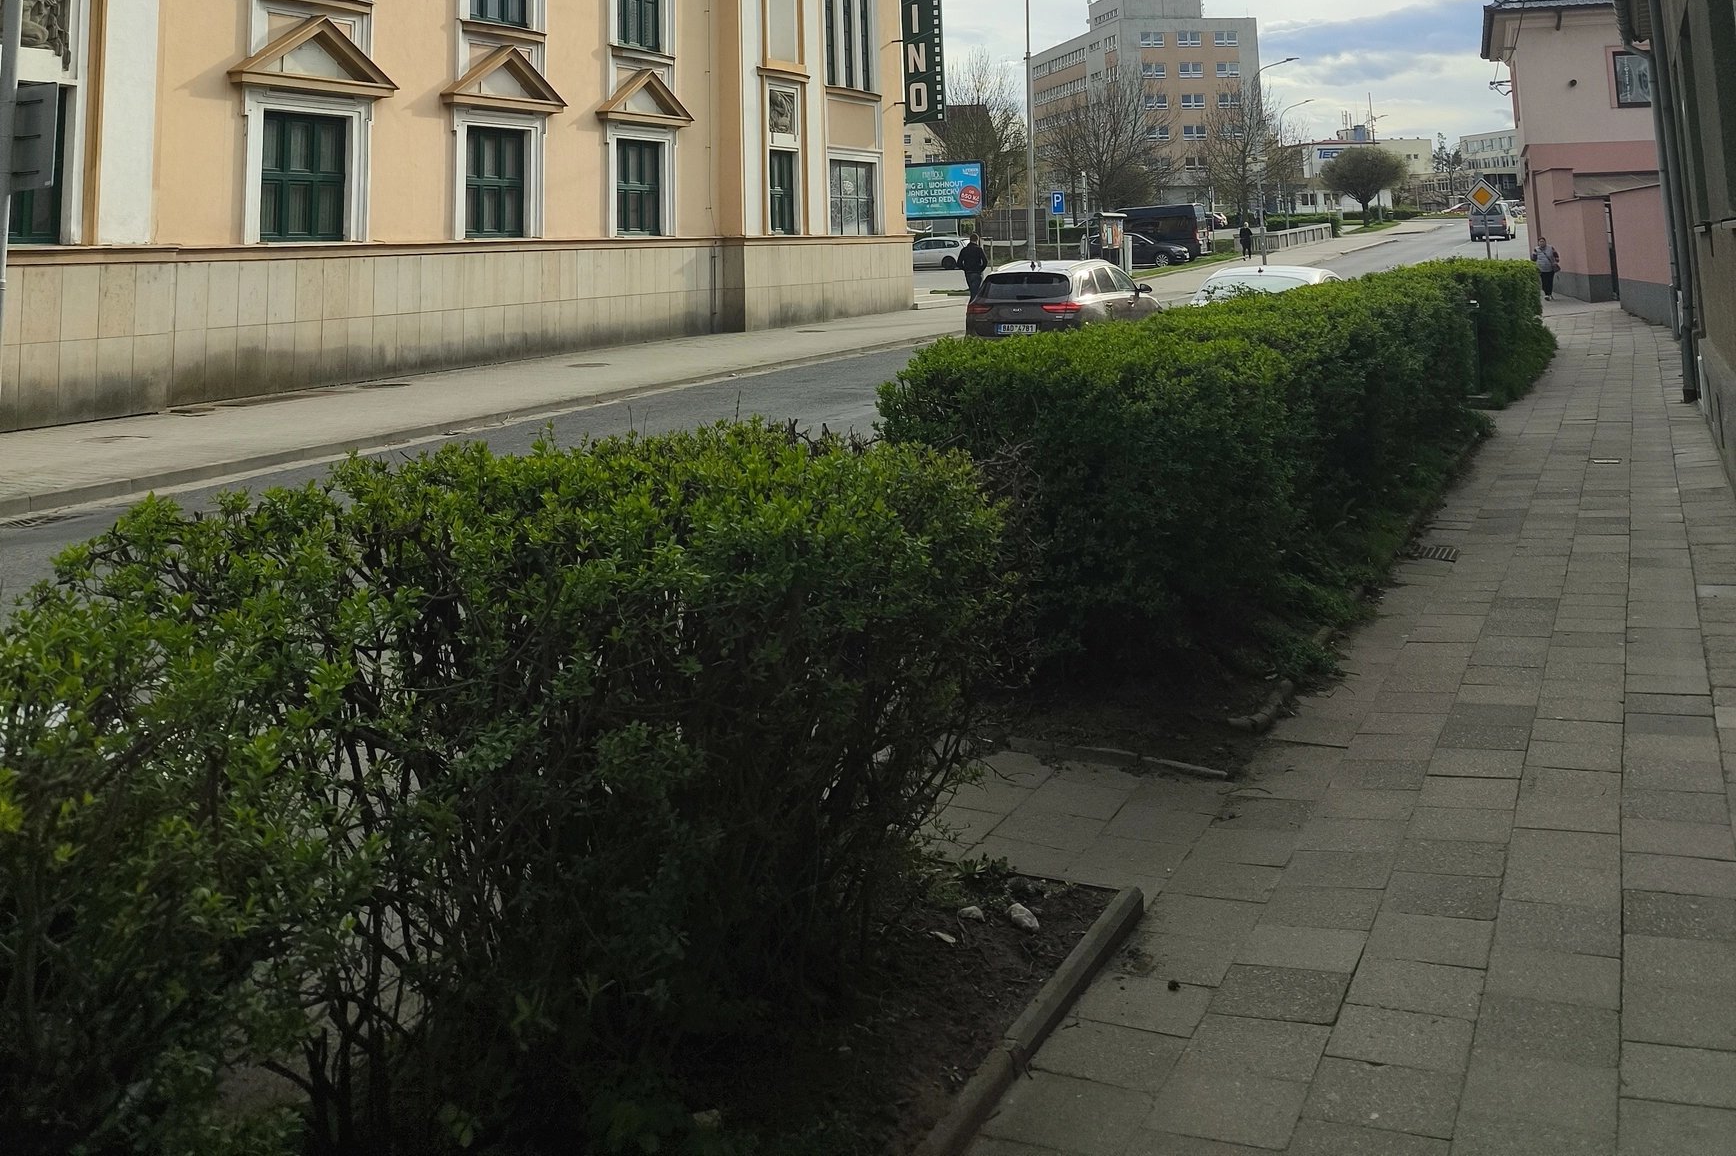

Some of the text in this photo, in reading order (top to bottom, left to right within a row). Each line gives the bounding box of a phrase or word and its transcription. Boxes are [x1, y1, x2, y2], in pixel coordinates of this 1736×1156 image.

[929, 180, 964, 189] WOHNOUT
[908, 187, 960, 197] JANEK LEDECKÝ
[1054, 194, 1062, 207] P
